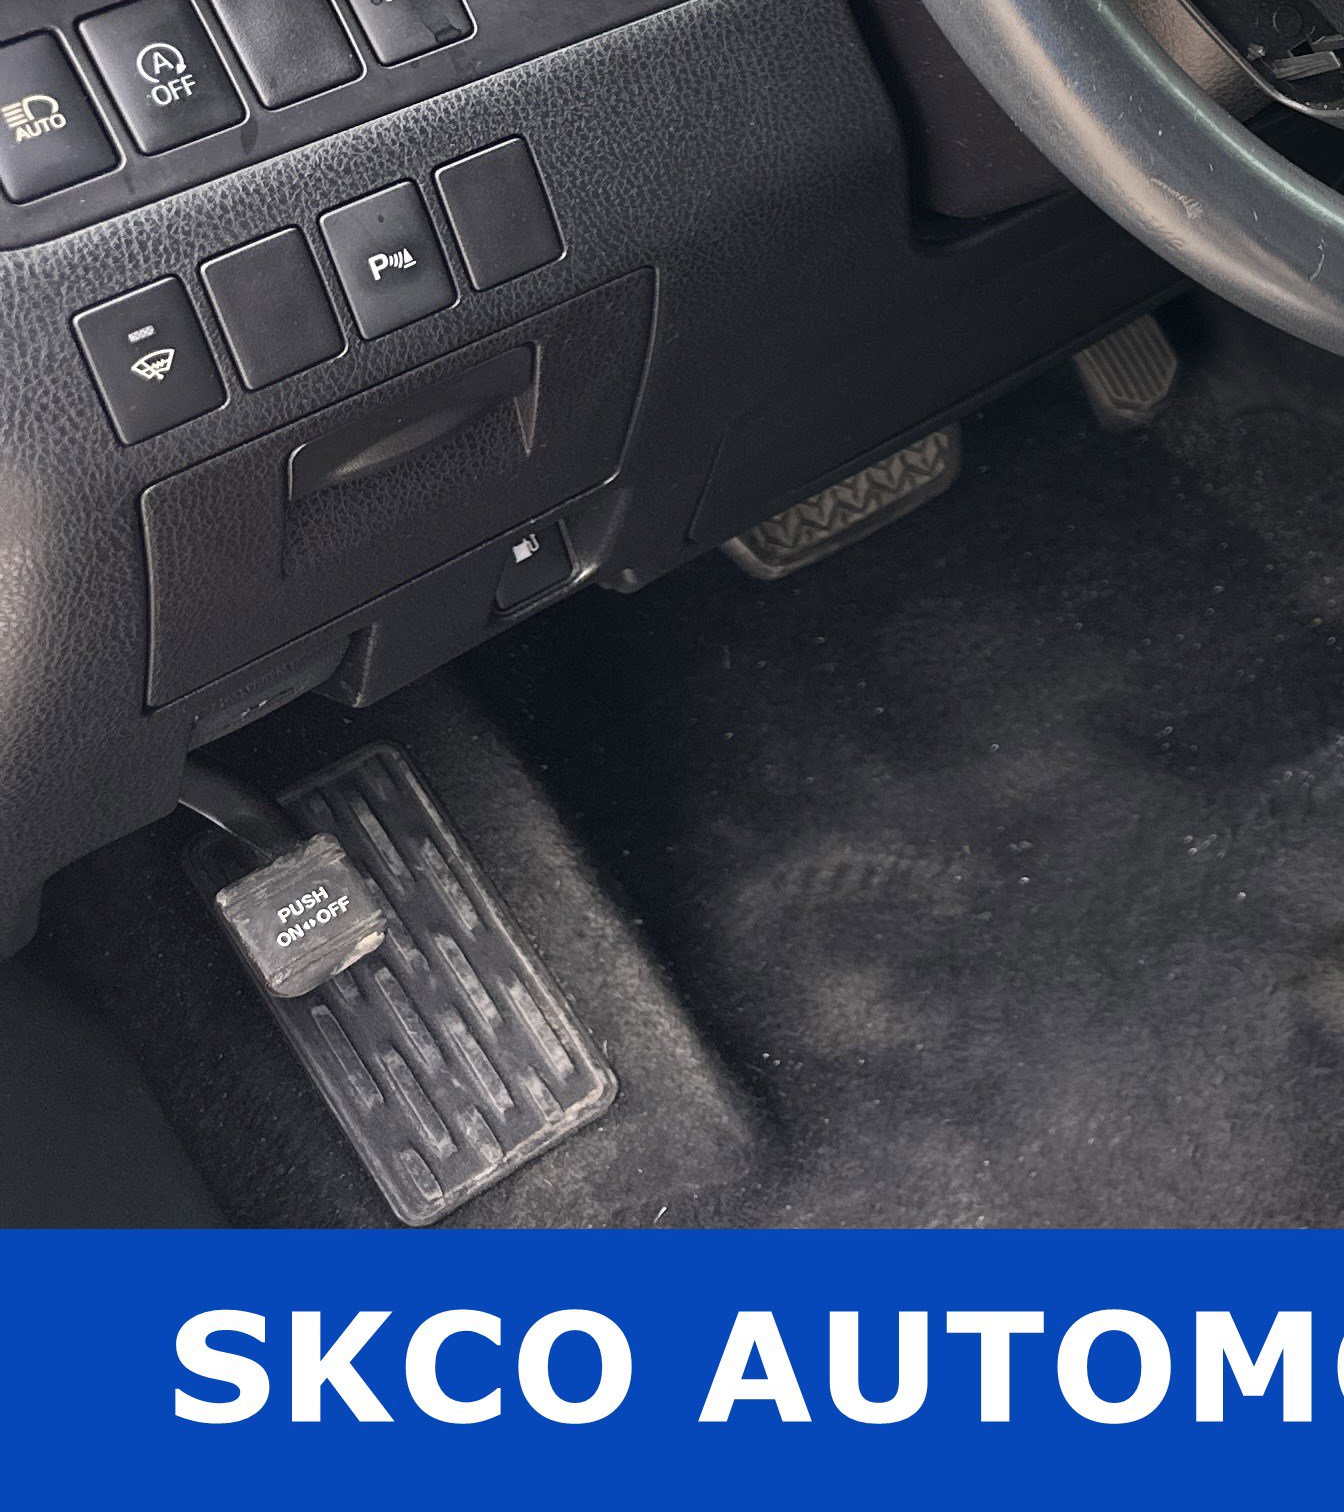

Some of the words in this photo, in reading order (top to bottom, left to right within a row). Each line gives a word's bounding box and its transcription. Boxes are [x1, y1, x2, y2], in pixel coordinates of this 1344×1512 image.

[150, 76, 196, 106] OFF
[14, 111, 67, 142] AUTO
[367, 252, 390, 281] P
[277, 886, 329, 924] PUSH
[276, 923, 305, 948] ON
[316, 895, 350, 924] OFF
